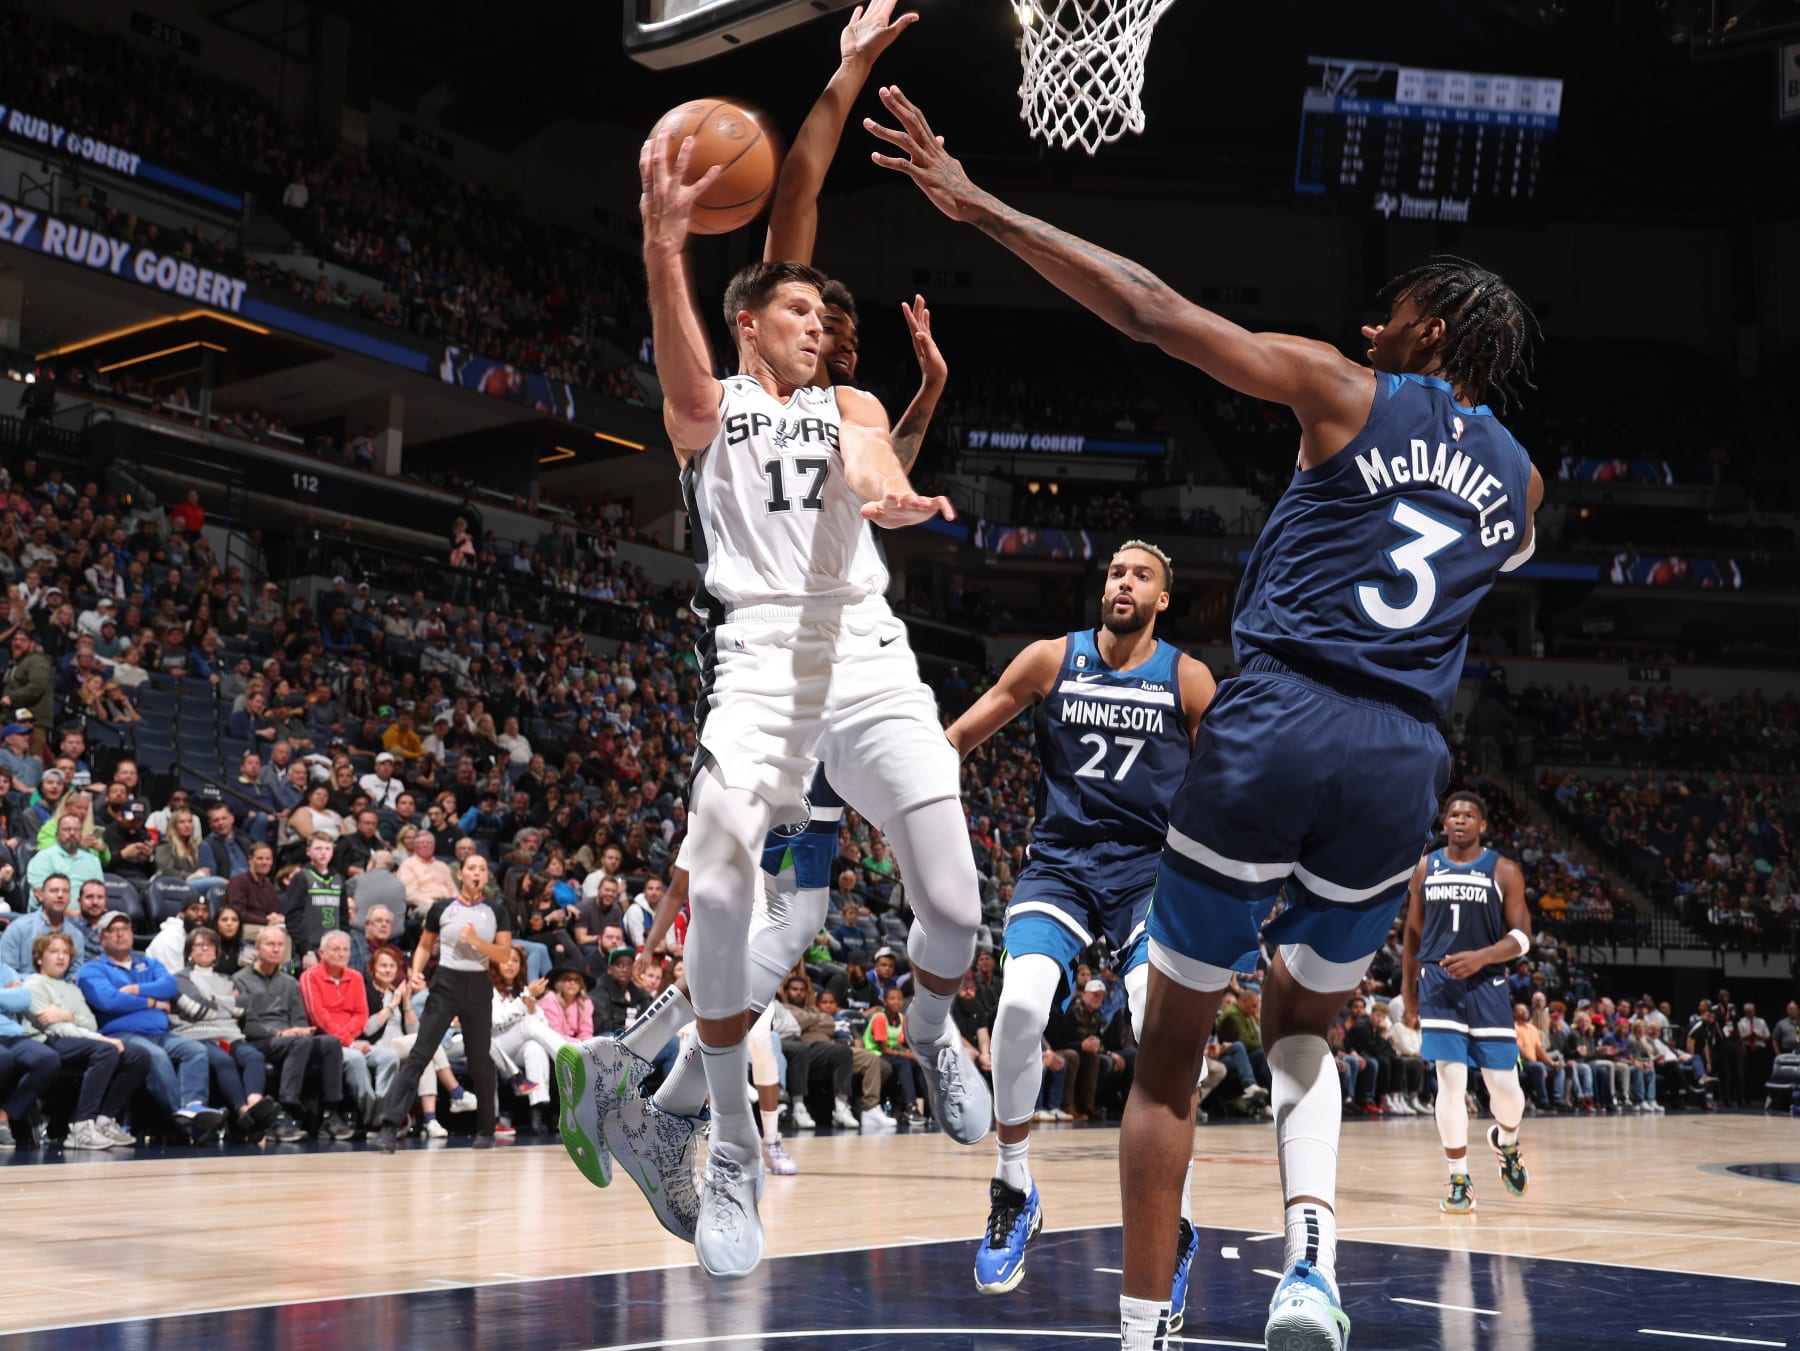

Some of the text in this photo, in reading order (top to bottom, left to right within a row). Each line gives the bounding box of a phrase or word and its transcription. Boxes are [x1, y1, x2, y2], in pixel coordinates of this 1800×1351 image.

[8, 109, 64, 147] RUDY
[66, 132, 141, 176] GOBERT
[0, 203, 247, 312] 27 RUDY GOBERT
[725, 413, 839, 452] SPURS
[968, 431, 1085, 453] 27 RUDY GOBERT
[291, 472, 319, 493] 112
[762, 456, 829, 515] 17
[1354, 439, 1515, 548] McDANIELS
[1354, 497, 1466, 632] 3
[1076, 655, 1086, 668] 6
[1061, 698, 1164, 734] MINNESOTA
[1075, 733, 1146, 781] 27
[1425, 885, 1487, 904] MINNESOTA
[321, 906, 336, 928] 3
[1450, 903, 1460, 933] 1
